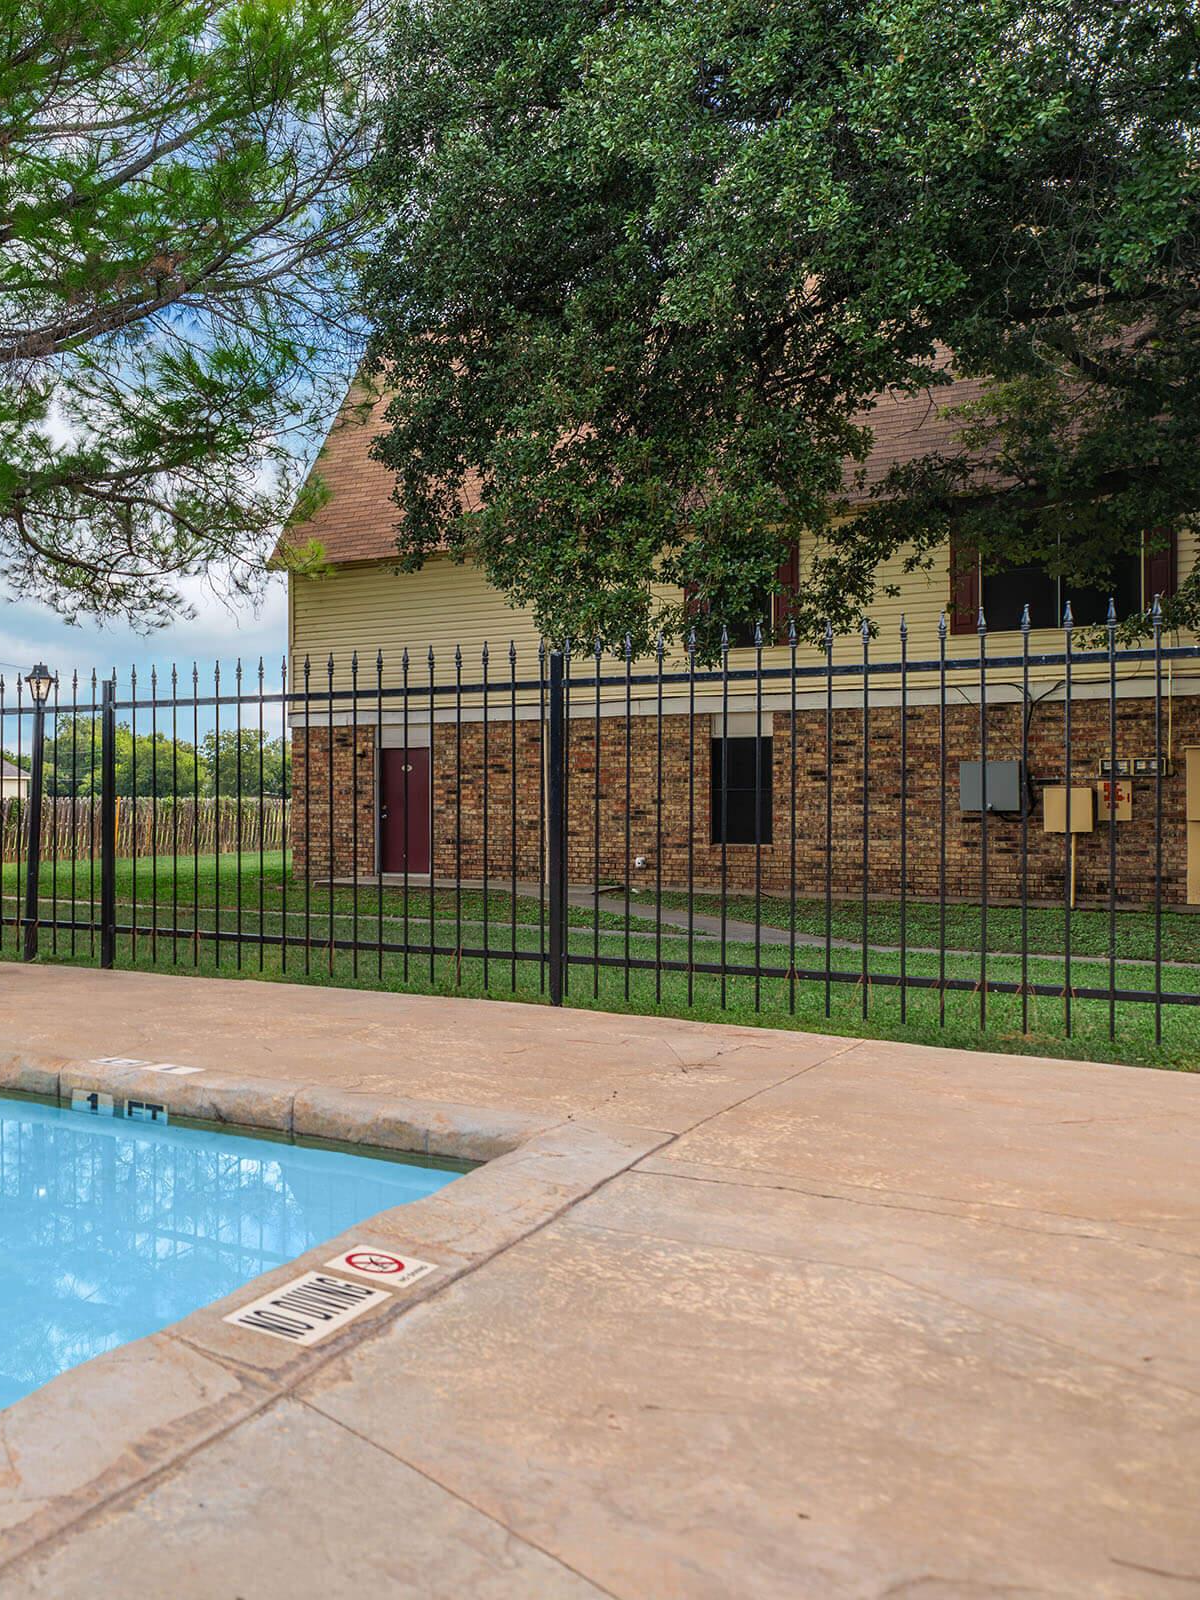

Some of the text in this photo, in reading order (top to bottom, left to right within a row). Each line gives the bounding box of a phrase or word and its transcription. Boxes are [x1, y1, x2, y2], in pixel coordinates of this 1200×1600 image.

[87, 1093, 164, 1120] 1 FT
[238, 1278, 376, 1339] NO DIVING
